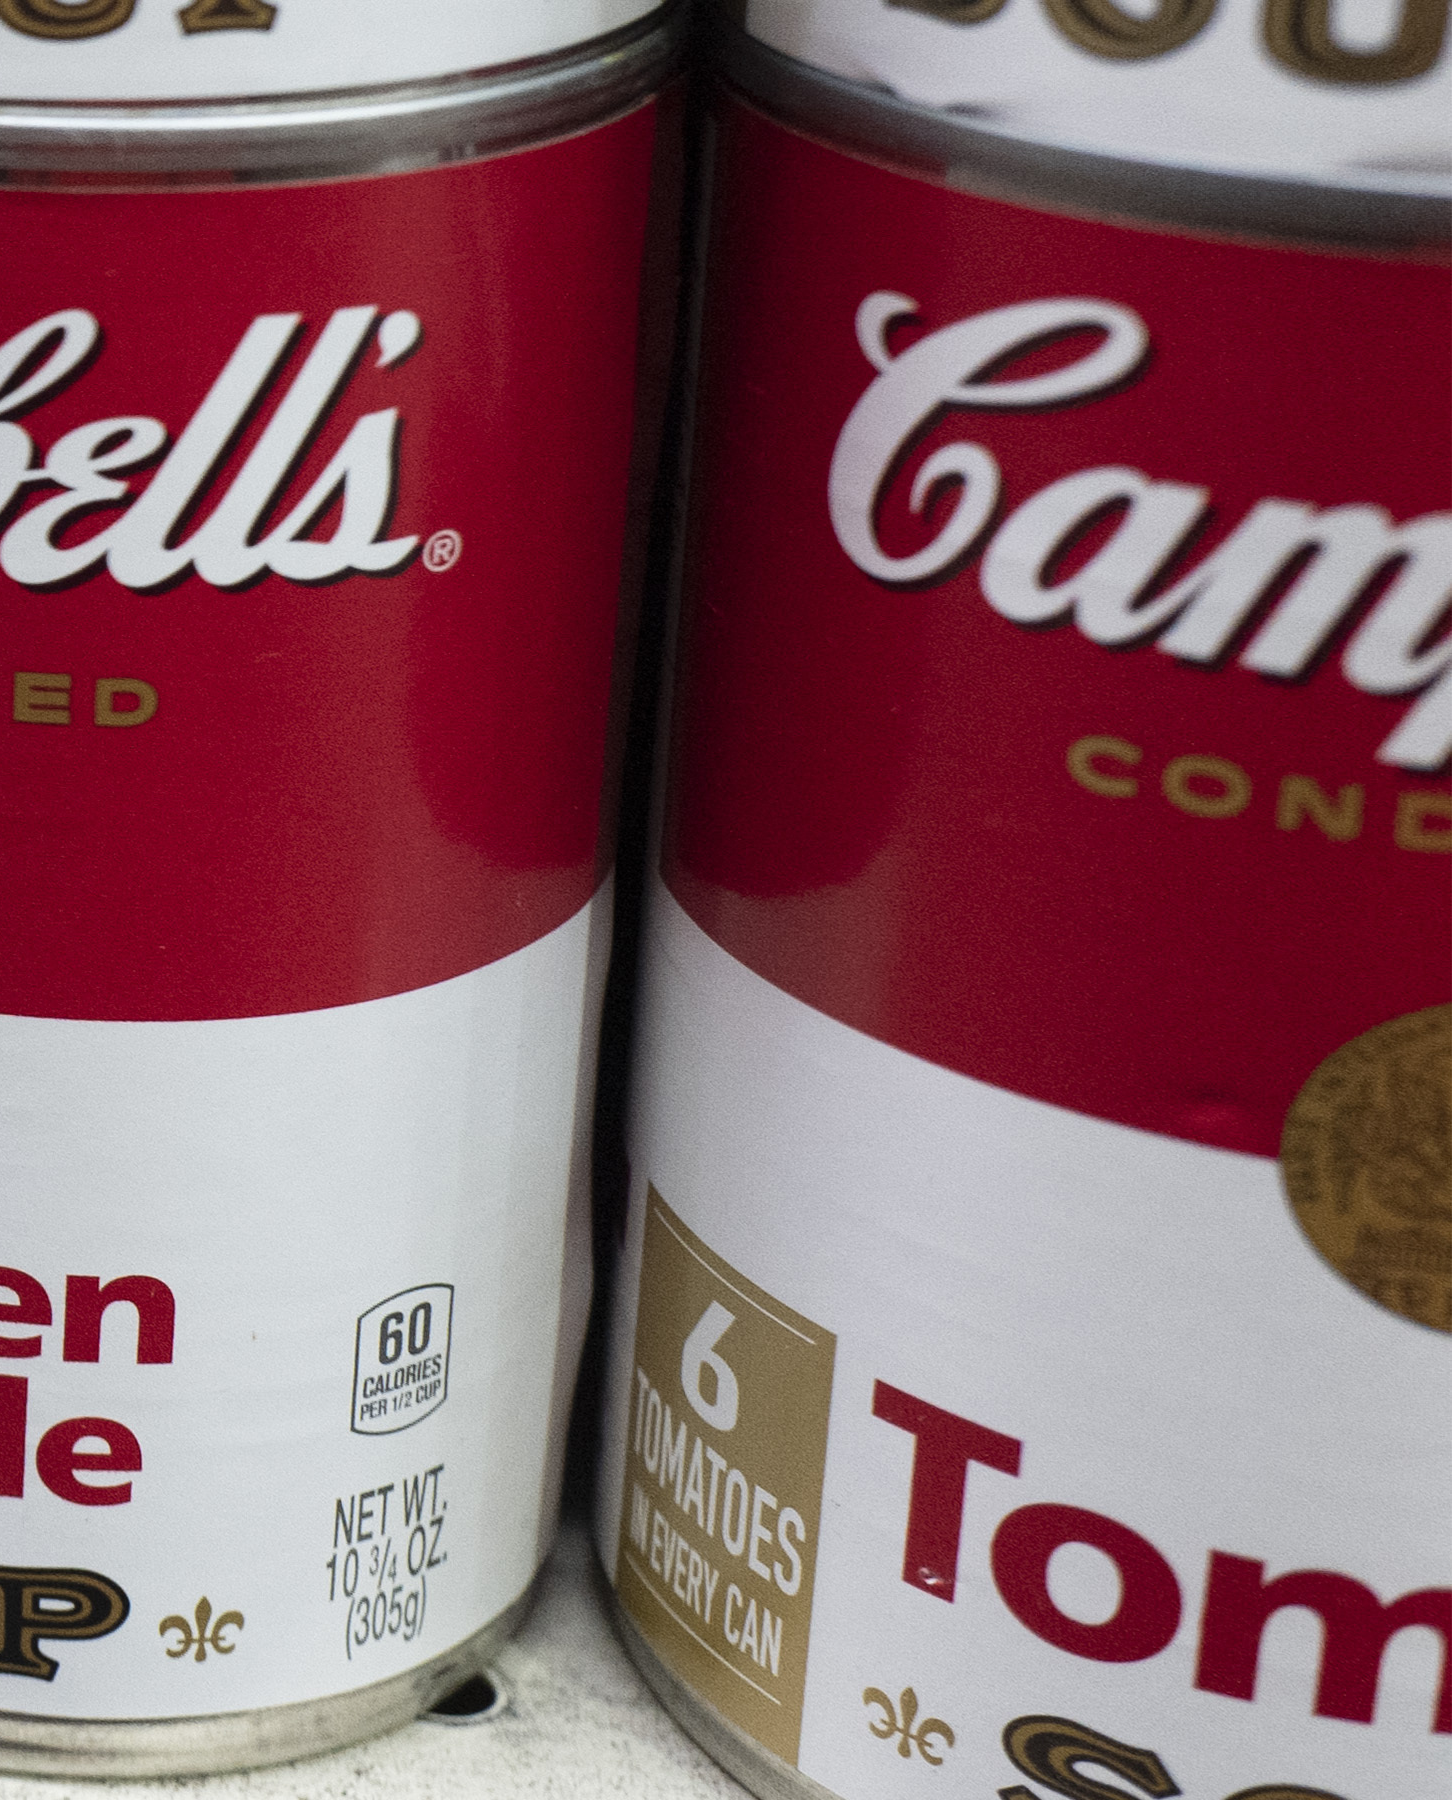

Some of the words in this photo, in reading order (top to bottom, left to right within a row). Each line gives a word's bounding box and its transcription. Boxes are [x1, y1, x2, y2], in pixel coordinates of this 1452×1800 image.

[362, 1353, 443, 1400] CALORIES
[378, 1301, 433, 1366] 60
[681, 1300, 740, 1432] 6
[359, 1401, 388, 1422] PER
[391, 1392, 413, 1414] 1/2
[415, 1378, 443, 1407] CUP
[333, 1483, 395, 1549] NET
[402, 1463, 448, 1528] WT.
[634, 1365, 806, 1597] TOMATOES
[326, 1548, 360, 1602] 10
[406, 1518, 449, 1577] OZ.
[649, 1508, 720, 1625] EVERY
[723, 1582, 784, 1678] CAN
[347, 1574, 427, 1661] (305g)
